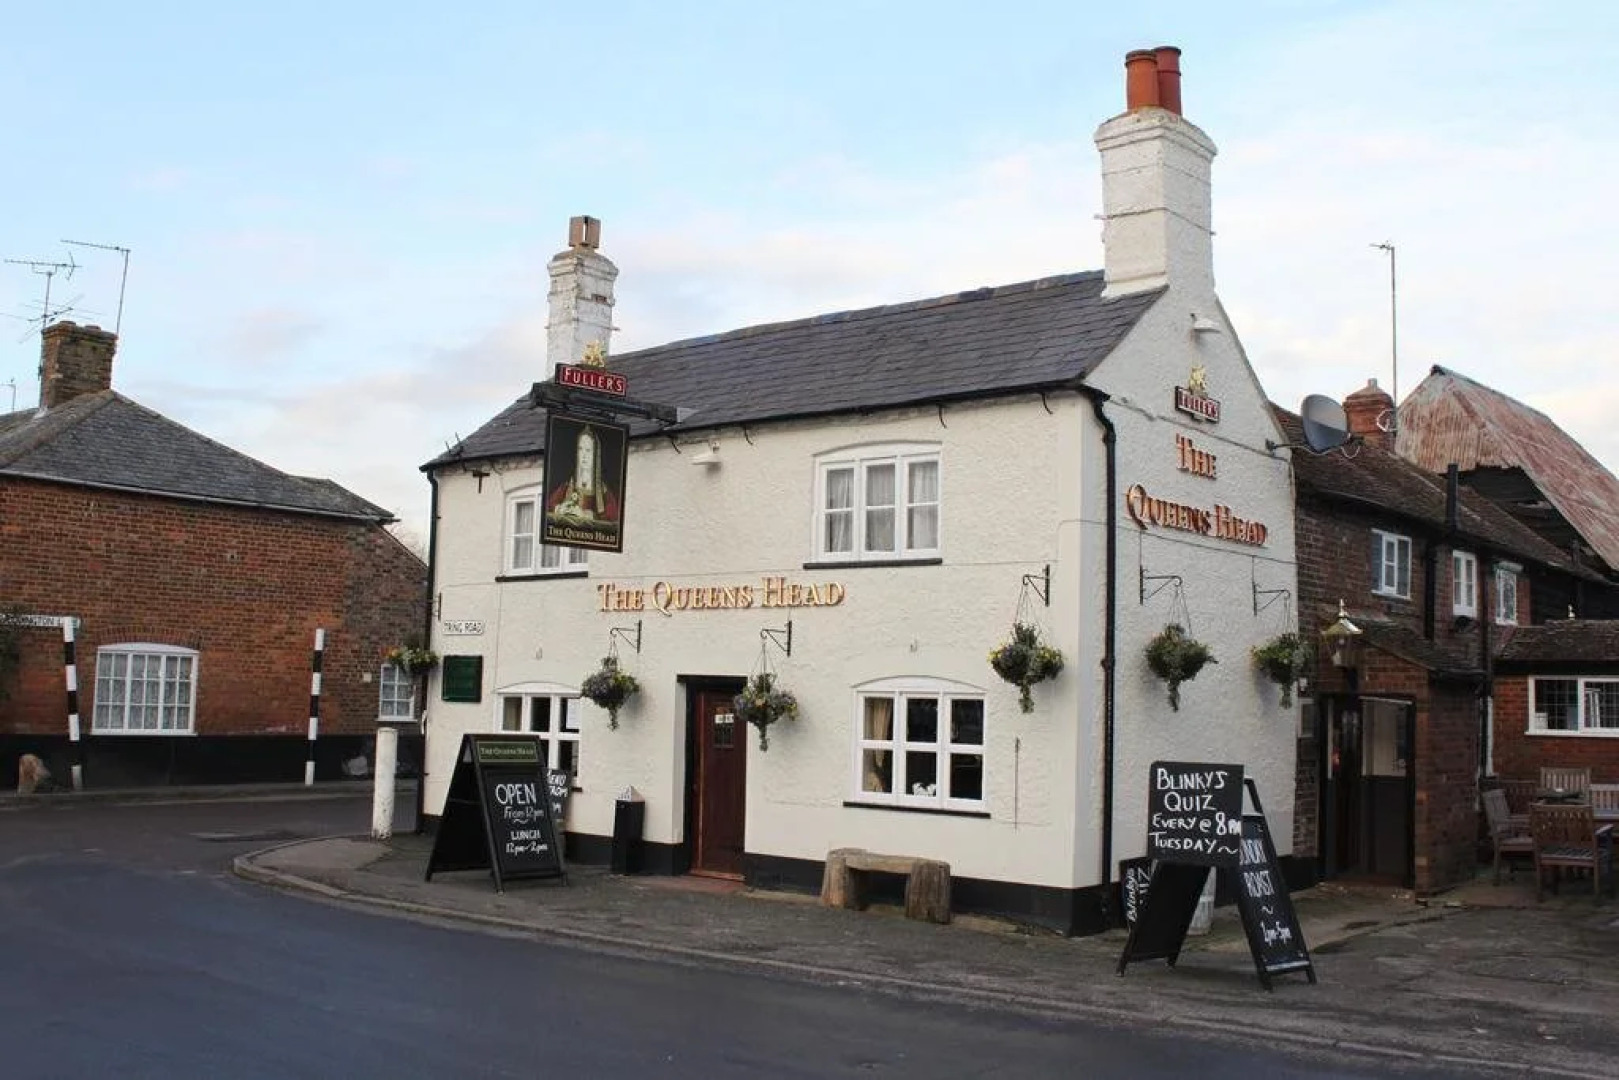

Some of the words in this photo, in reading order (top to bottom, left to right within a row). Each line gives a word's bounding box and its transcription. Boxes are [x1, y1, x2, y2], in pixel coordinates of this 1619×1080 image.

[1176, 433, 1217, 481] THE
[1214, 504, 1269, 547] HEAD
[597, 582, 645, 612] THE
[652, 581, 754, 617] QUEENS
[762, 576, 846, 608] HEAD
[464, 622, 483, 633] ROAD
[495, 782, 537, 805] OPEN
[1164, 791, 1217, 812] QUIZ
[1152, 812, 1197, 830] EVERY
[1149, 831, 1217, 854] TUESDAY
